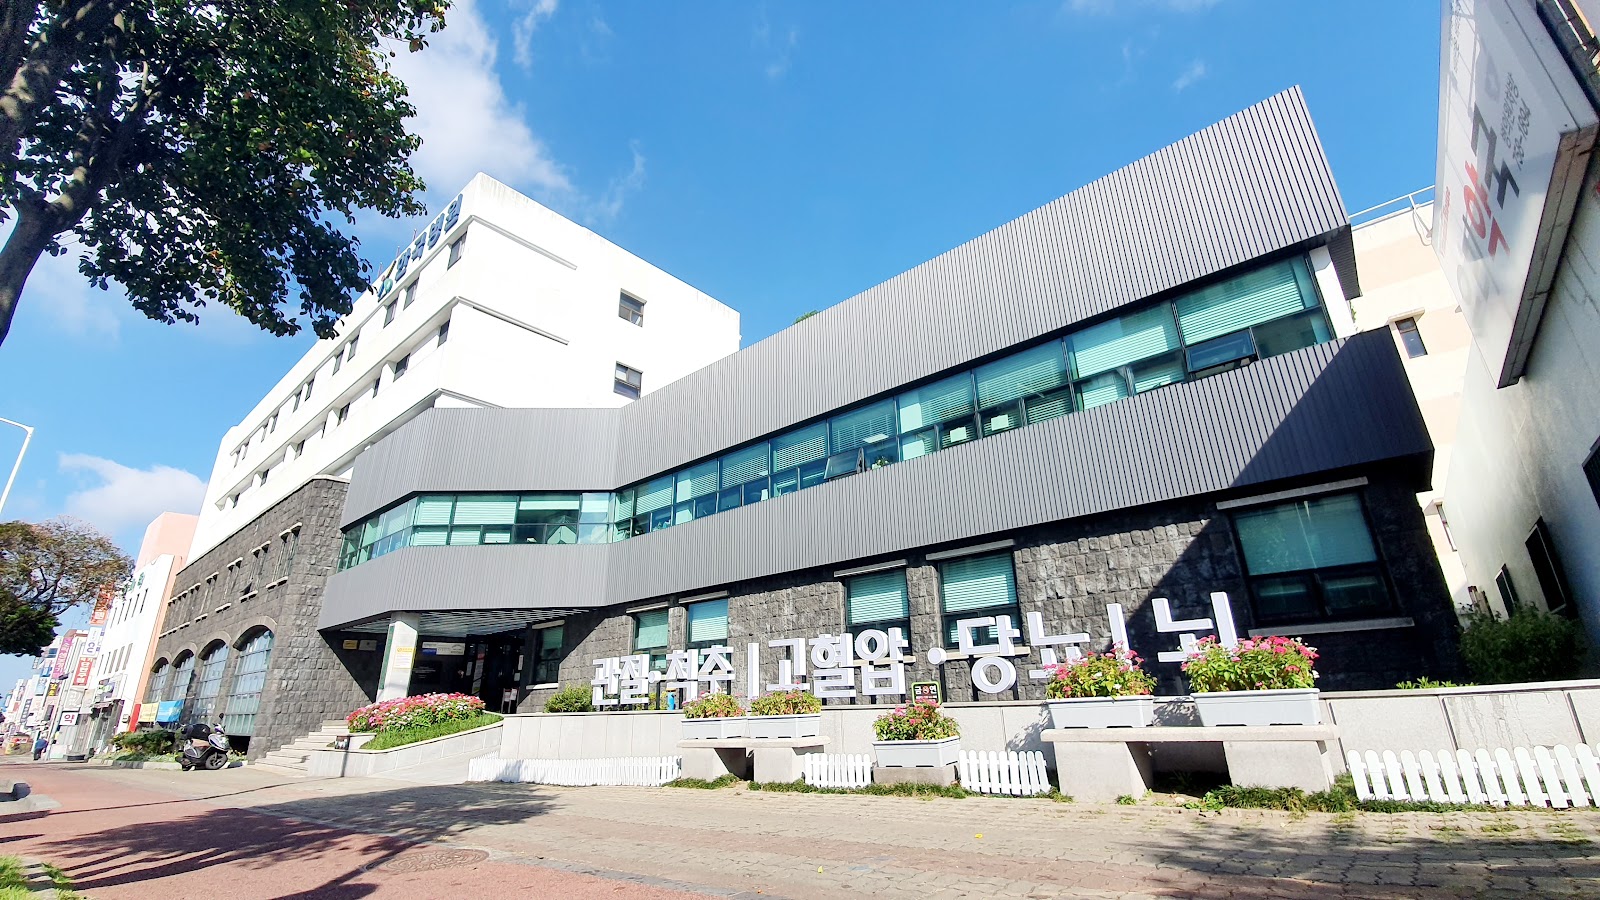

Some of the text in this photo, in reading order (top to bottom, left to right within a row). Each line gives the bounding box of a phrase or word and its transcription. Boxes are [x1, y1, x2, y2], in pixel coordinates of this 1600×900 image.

[1463, 102, 1520, 256] 약국
[395, 194, 464, 282] 한국병원
[86, 641, 96, 653] CU
[1152, 591, 1239, 664] 뇌
[64, 714, 75, 723] 약
